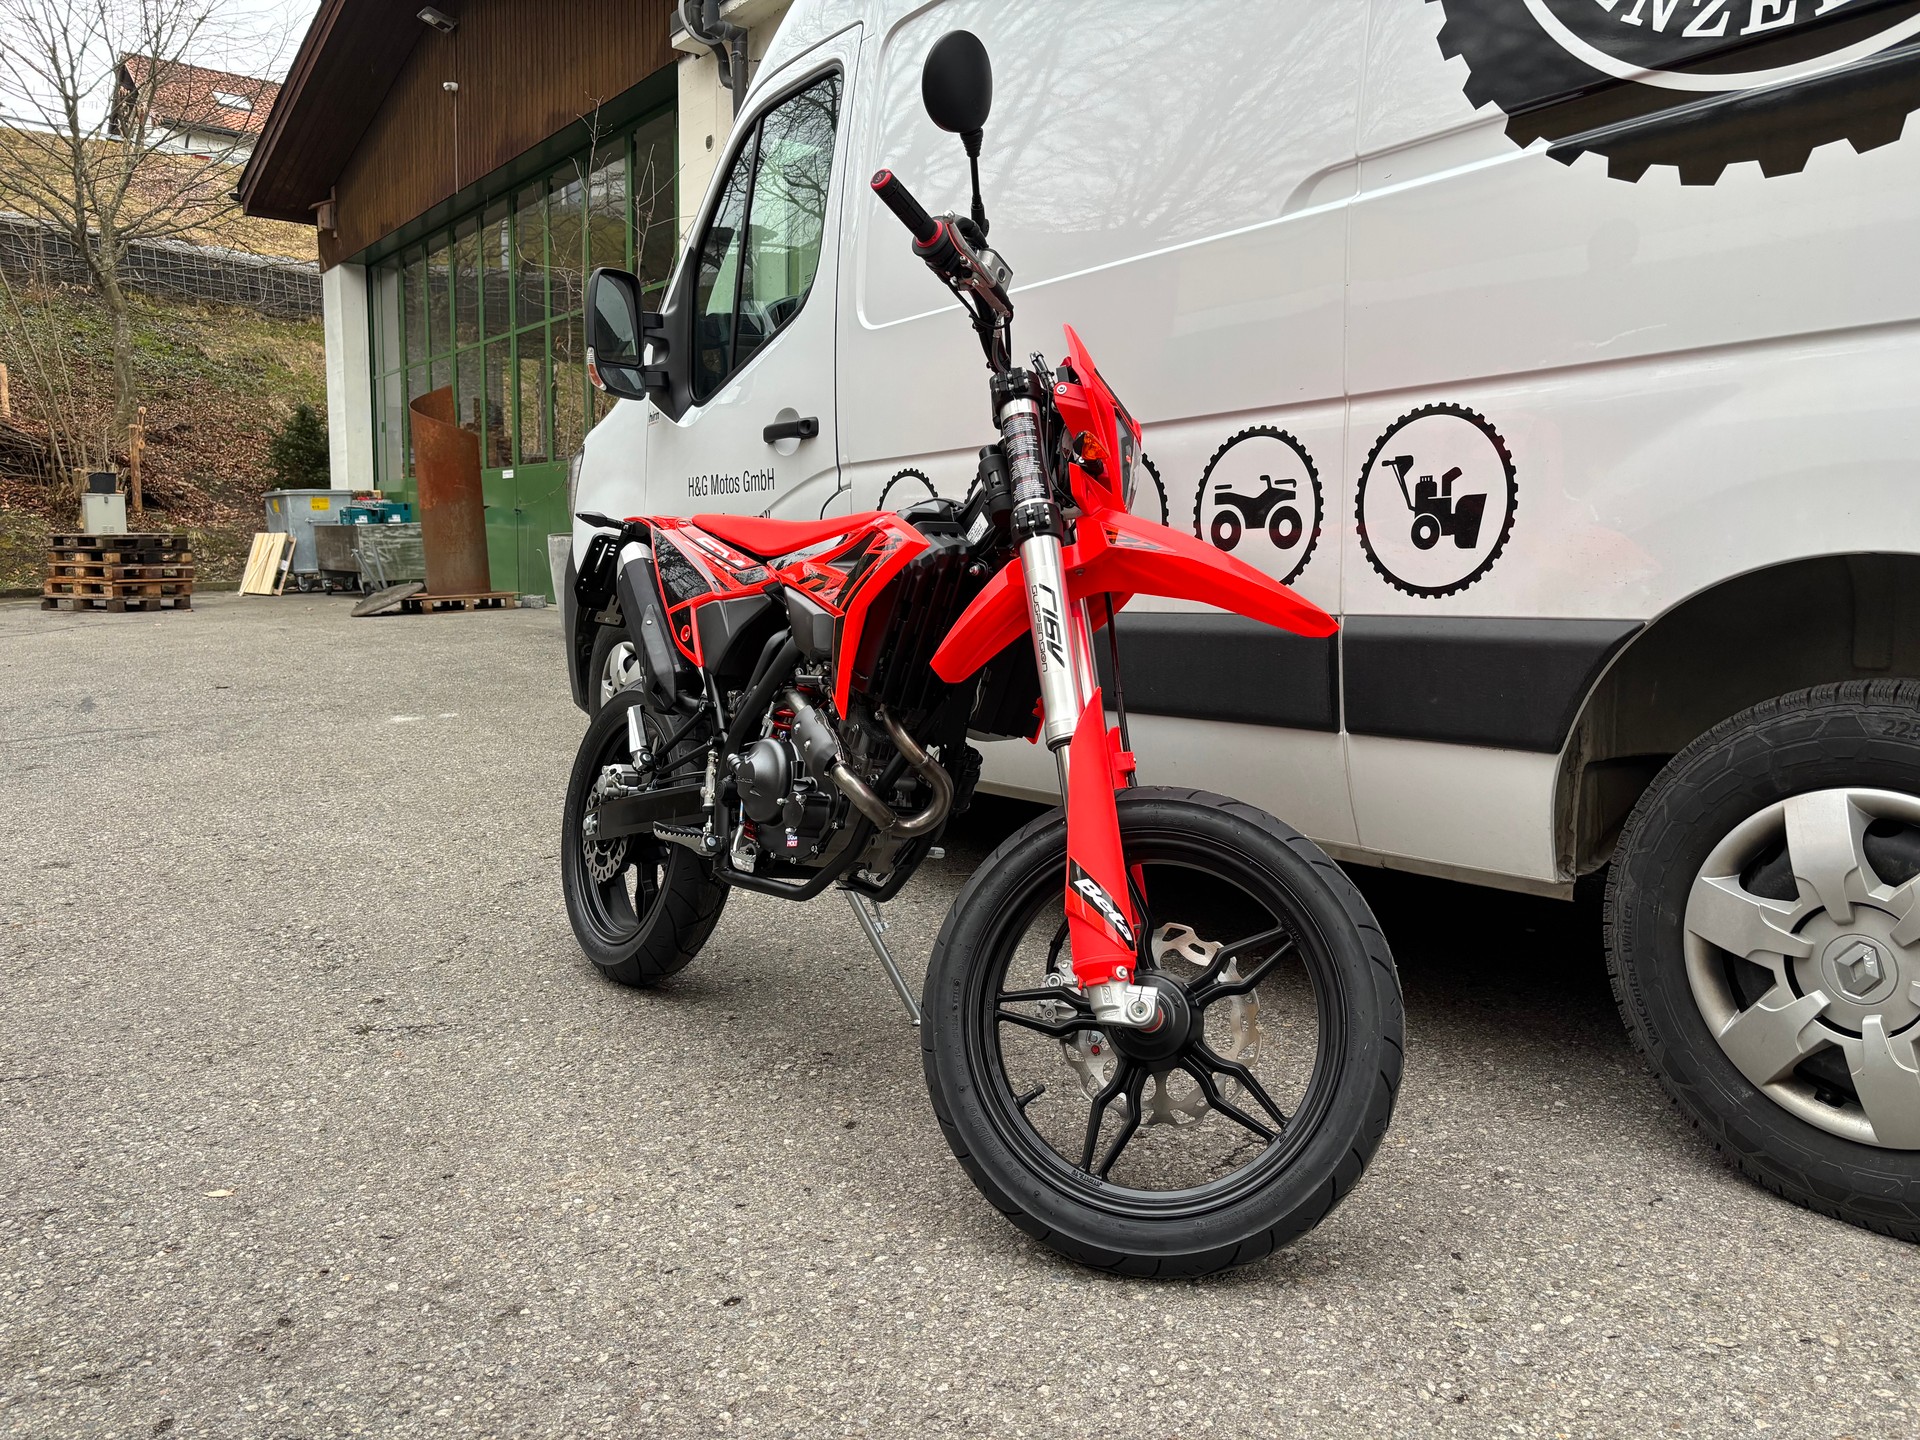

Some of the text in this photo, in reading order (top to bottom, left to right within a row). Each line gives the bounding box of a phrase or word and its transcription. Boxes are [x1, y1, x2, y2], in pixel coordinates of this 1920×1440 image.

[1595, 0, 1852, 38] NZE
[688, 468, 775, 497] H&G Motos GmbH
[1073, 878, 1133, 941] Beta
[1621, 902, 1660, 1046] VanContact Winter
